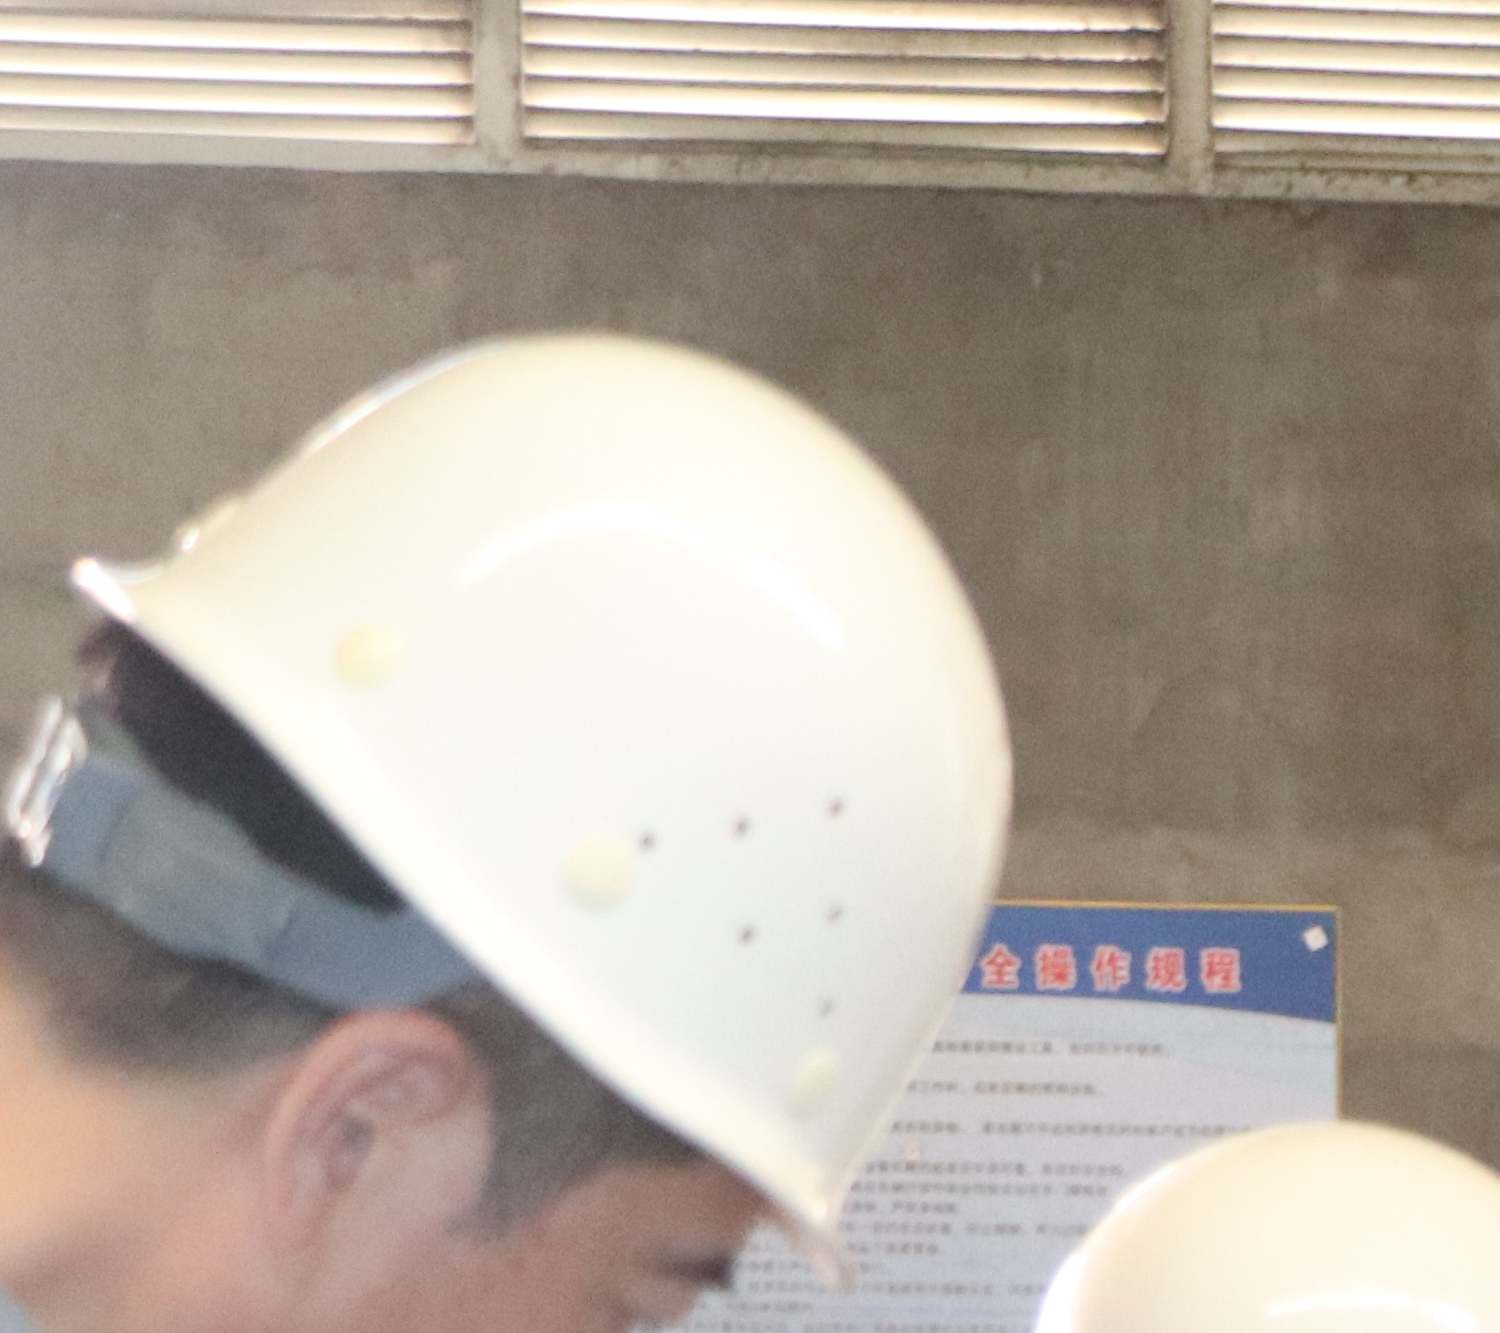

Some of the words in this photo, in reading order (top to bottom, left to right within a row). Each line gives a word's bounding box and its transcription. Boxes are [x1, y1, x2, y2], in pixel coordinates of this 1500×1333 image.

[979, 943, 1242, 994] 全操作规程
